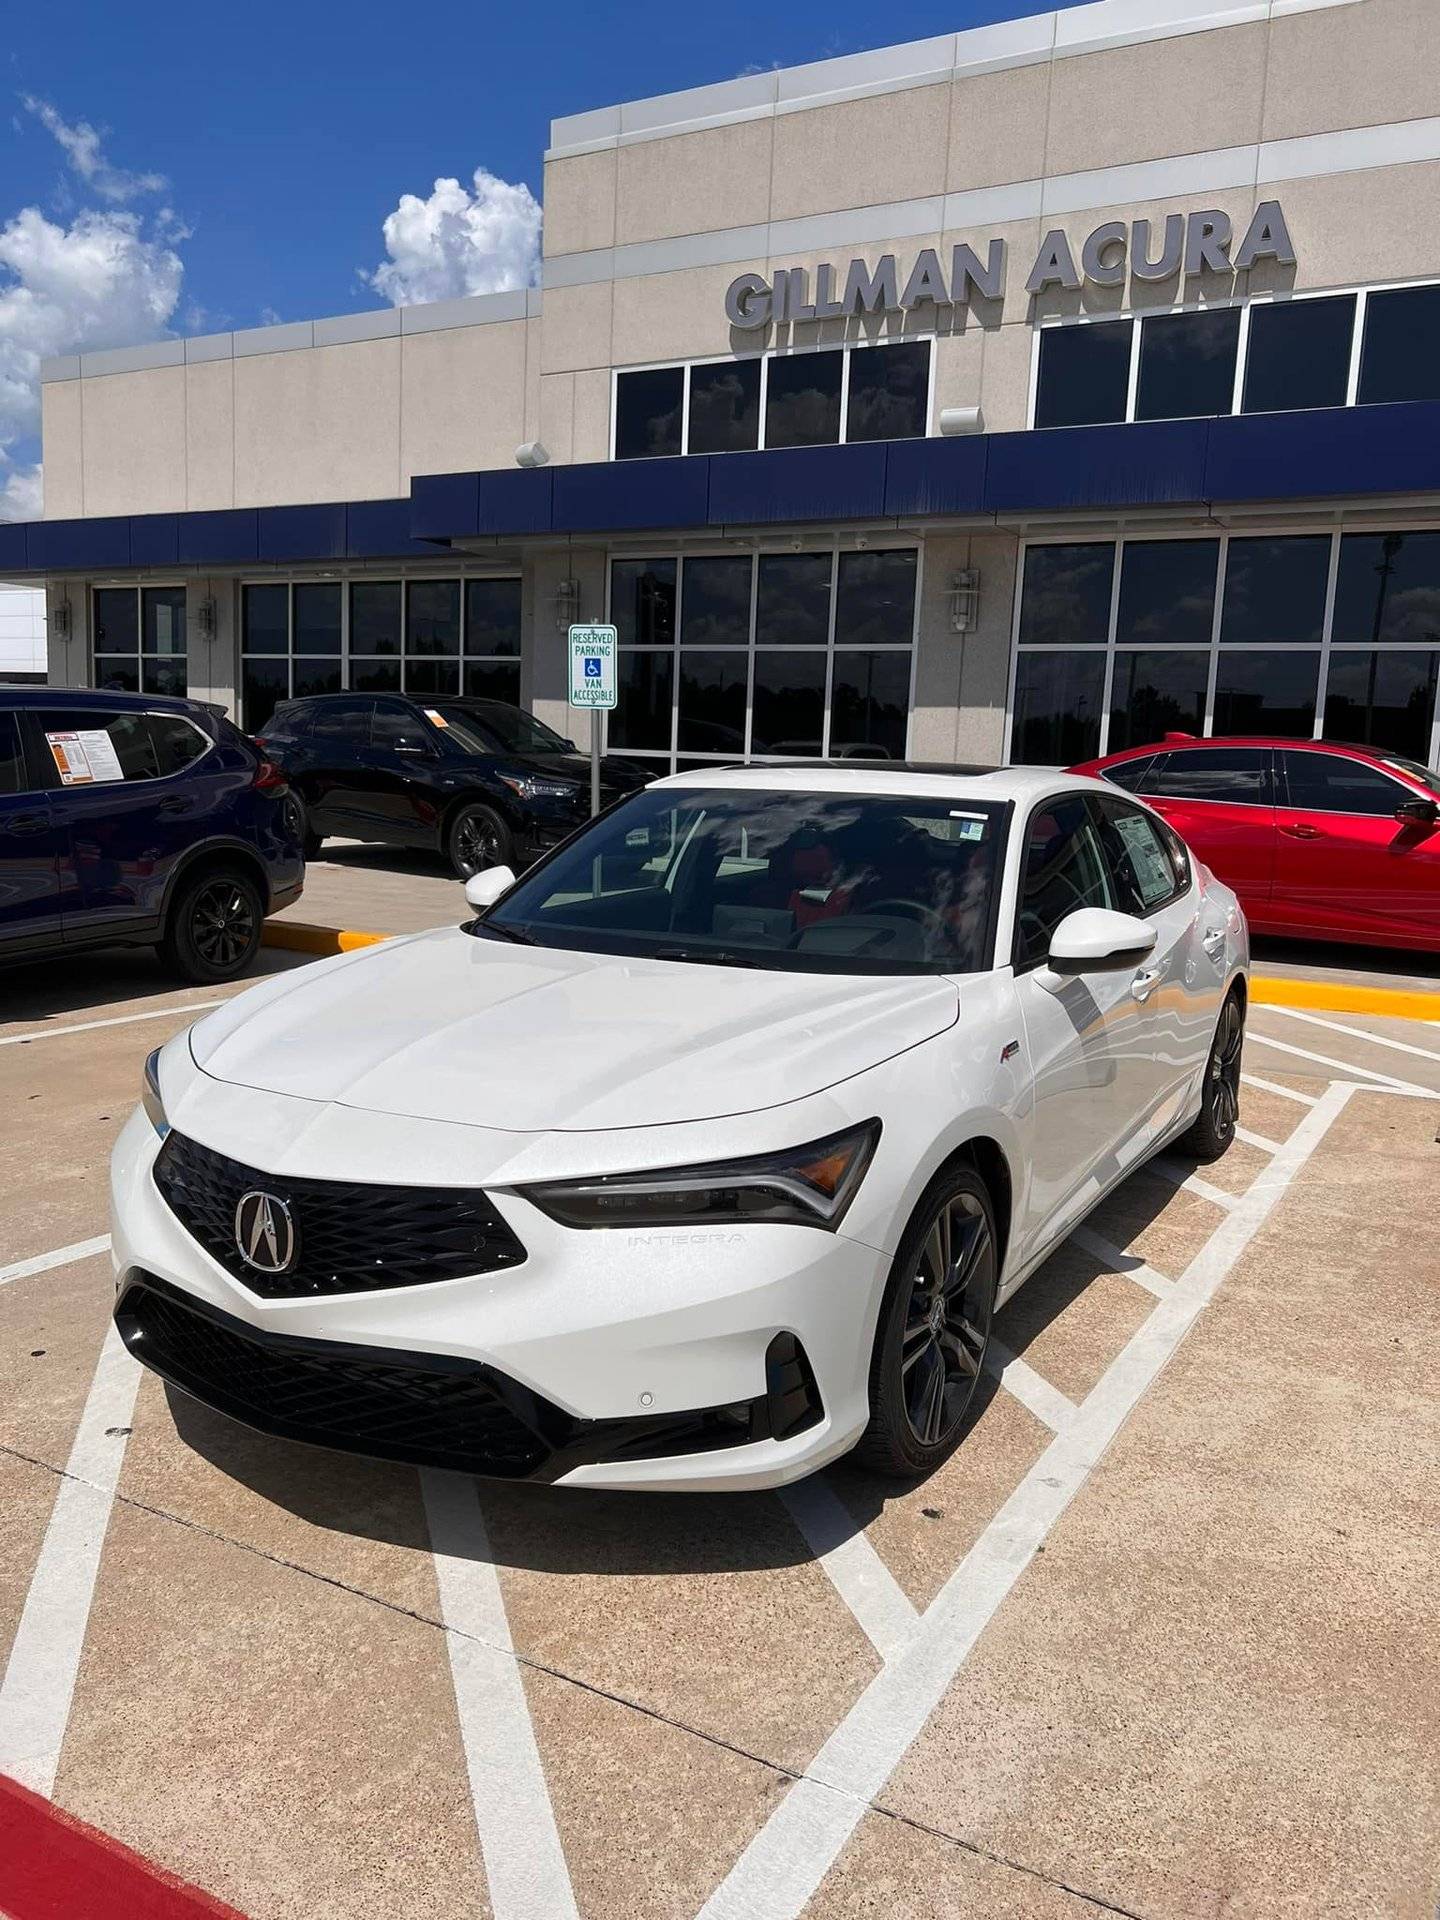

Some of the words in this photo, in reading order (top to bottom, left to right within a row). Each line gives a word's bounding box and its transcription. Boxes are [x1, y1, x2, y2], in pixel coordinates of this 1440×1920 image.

[725, 238, 1007, 331] GILLMAN
[1025, 199, 1297, 296] ACURA
[573, 633, 612, 643] RESERVED
[575, 646, 610, 656] PARKING
[585, 679, 602, 688] VAN
[574, 691, 613, 701] ACCESSIBLE
[628, 1233, 747, 1248] INTEGRA
